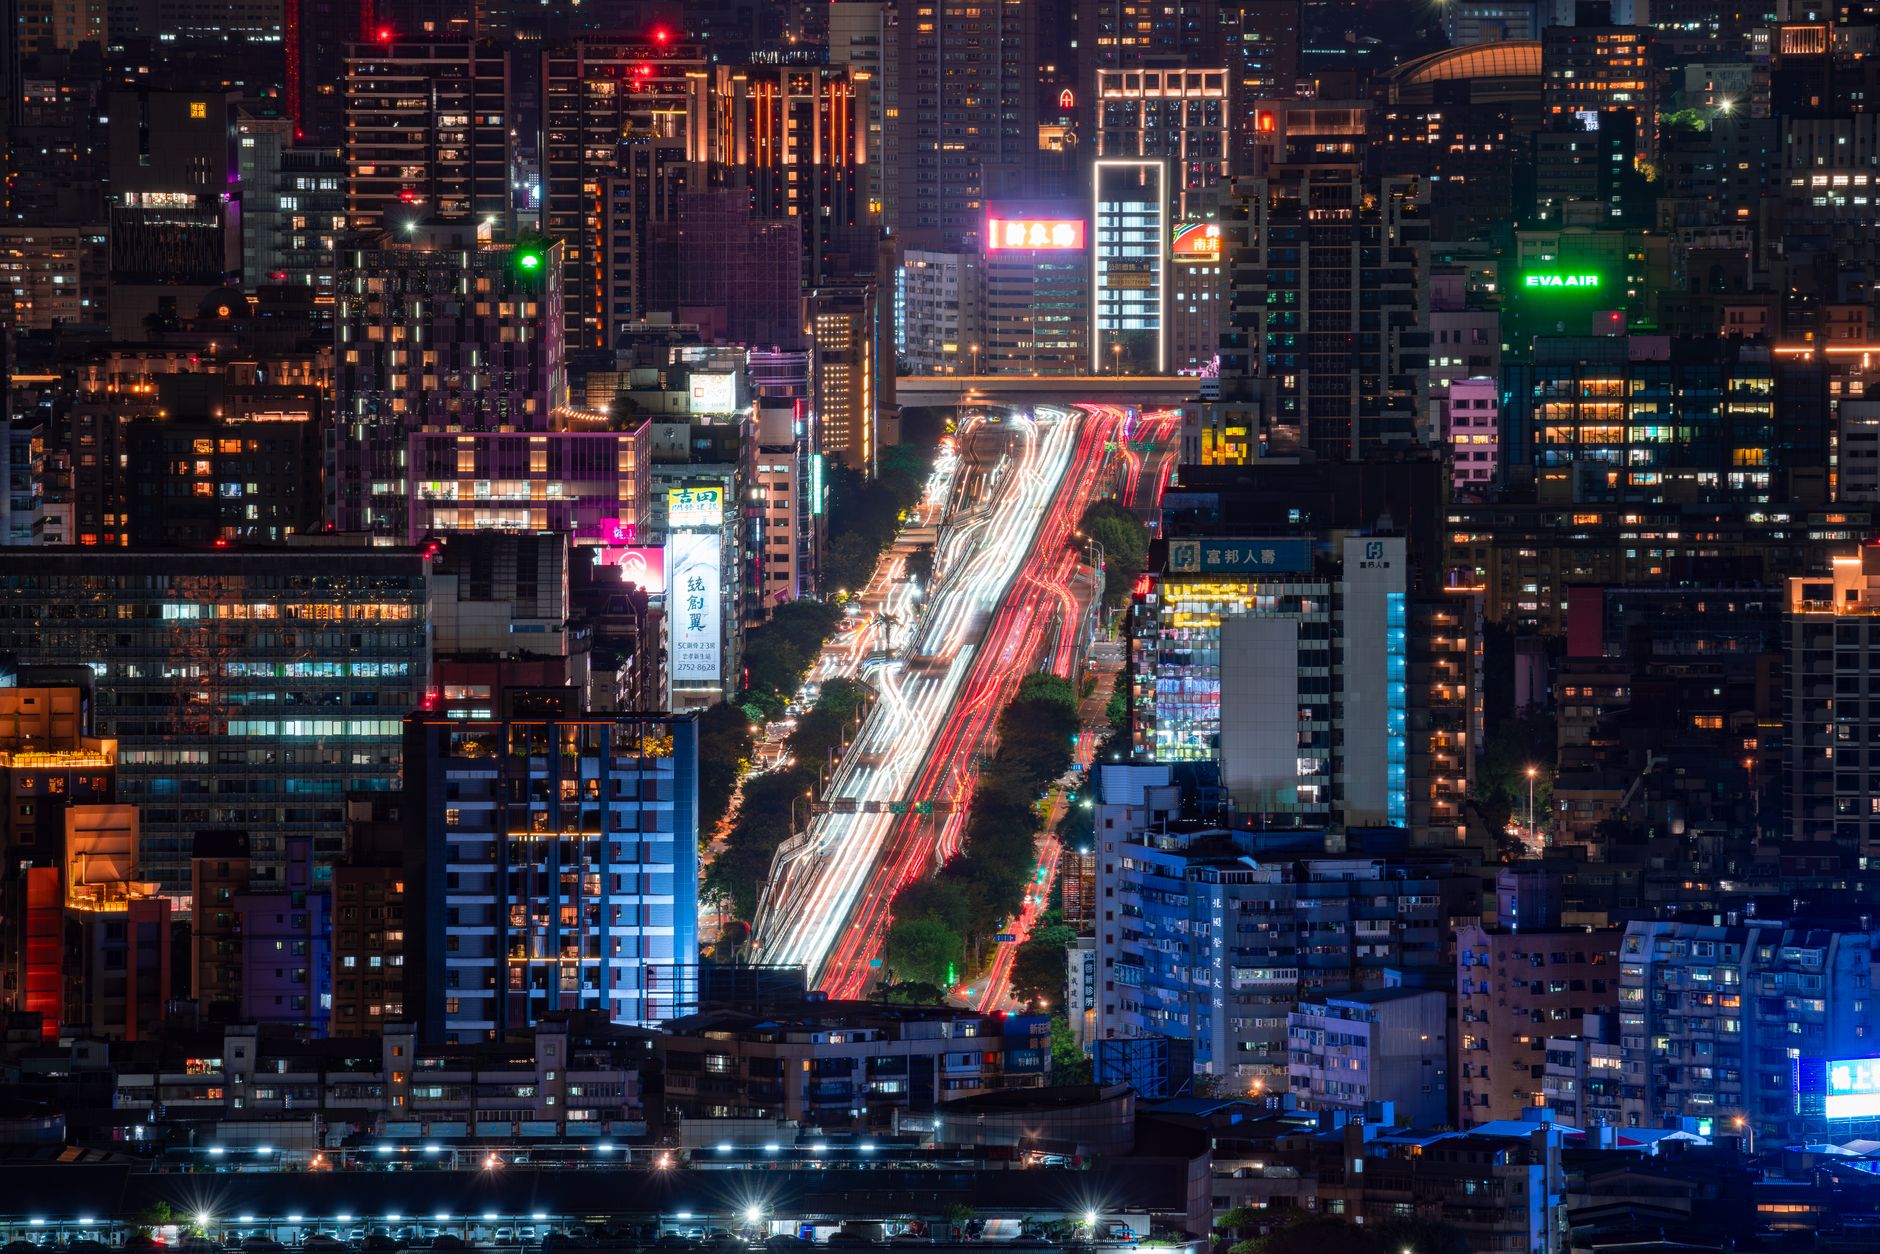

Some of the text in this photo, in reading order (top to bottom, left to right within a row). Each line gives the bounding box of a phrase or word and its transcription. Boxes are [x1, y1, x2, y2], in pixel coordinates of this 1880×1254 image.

[1193, 238, 1220, 251] 南非
[1526, 276, 1598, 286] EVA AIR
[672, 488, 718, 504] 吉田
[1206, 549, 1276, 565] 富邦人壽
[687, 575, 706, 632] 統創翼
[677, 663, 716, 671] 2752-8628
